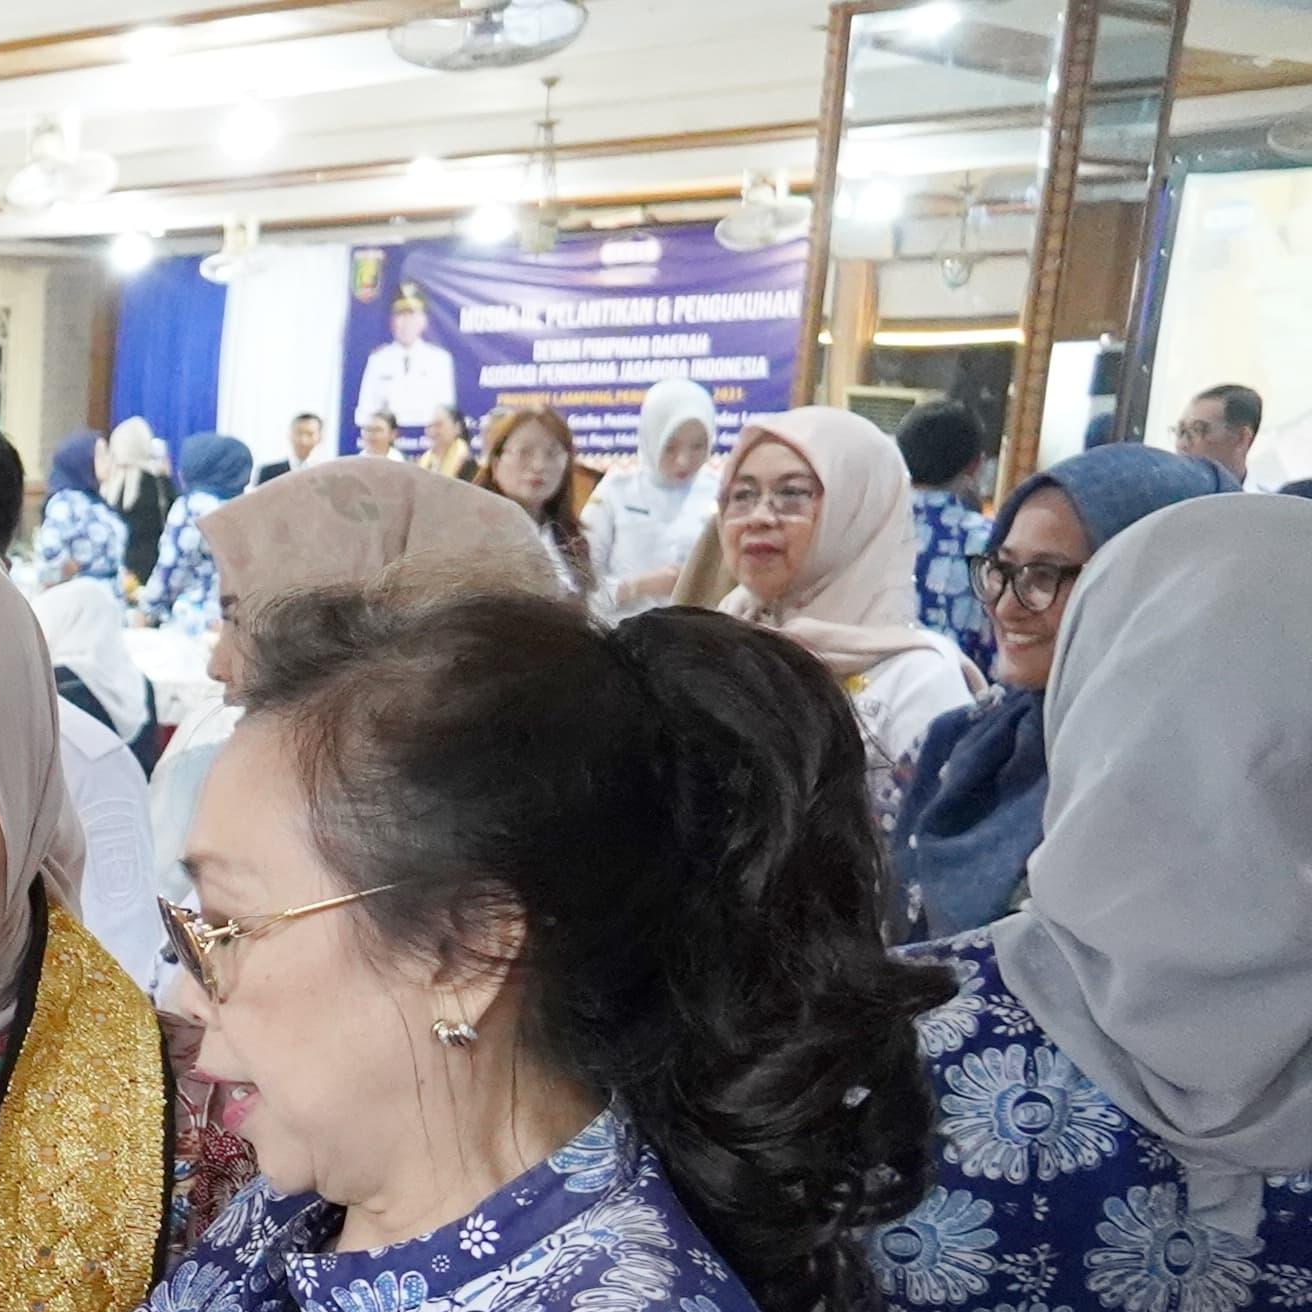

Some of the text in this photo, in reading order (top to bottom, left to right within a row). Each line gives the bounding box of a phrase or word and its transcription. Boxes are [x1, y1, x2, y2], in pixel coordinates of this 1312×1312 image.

[545, 297, 655, 330] PELANTIKAN
[656, 296, 672, 325] &
[673, 289, 801, 324] PENGUKUHAN
[651, 332, 710, 357] DAERAH
[690, 355, 769, 381] INDONESIA
